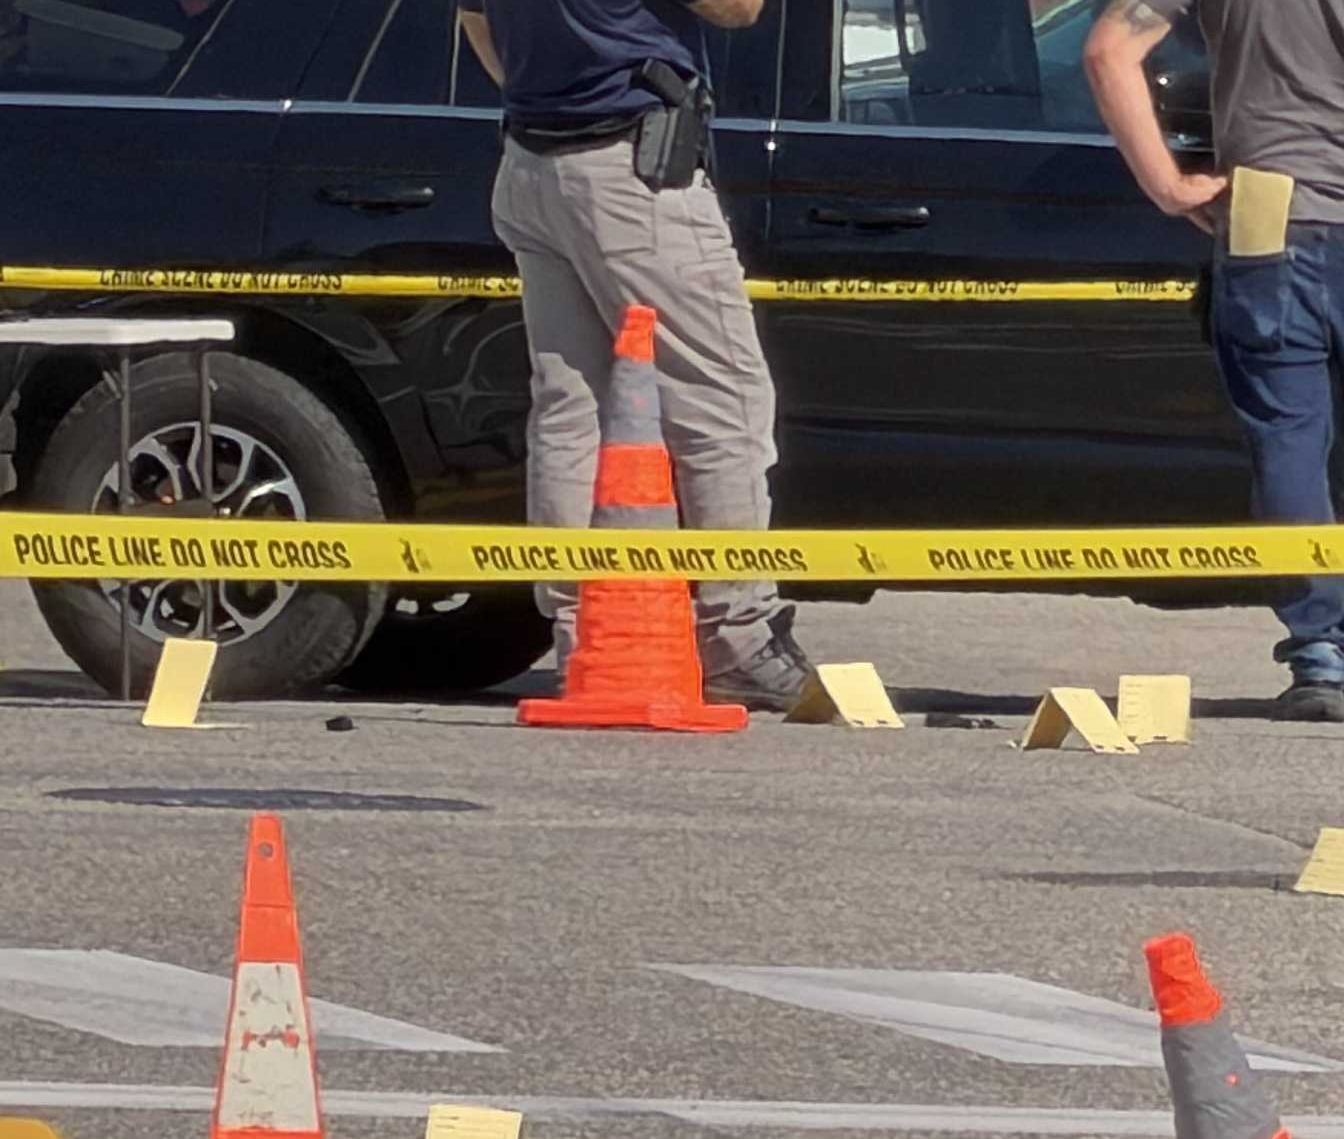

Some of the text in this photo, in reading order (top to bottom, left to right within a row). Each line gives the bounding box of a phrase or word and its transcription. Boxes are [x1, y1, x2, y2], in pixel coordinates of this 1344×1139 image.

[13, 533, 352, 569] POLICE LINE DO NOT CROSS
[472, 545, 808, 572] POLICE LINE DO NOT CROSS
[928, 546, 1261, 571] POLICE LINE DO NOT CROSS
